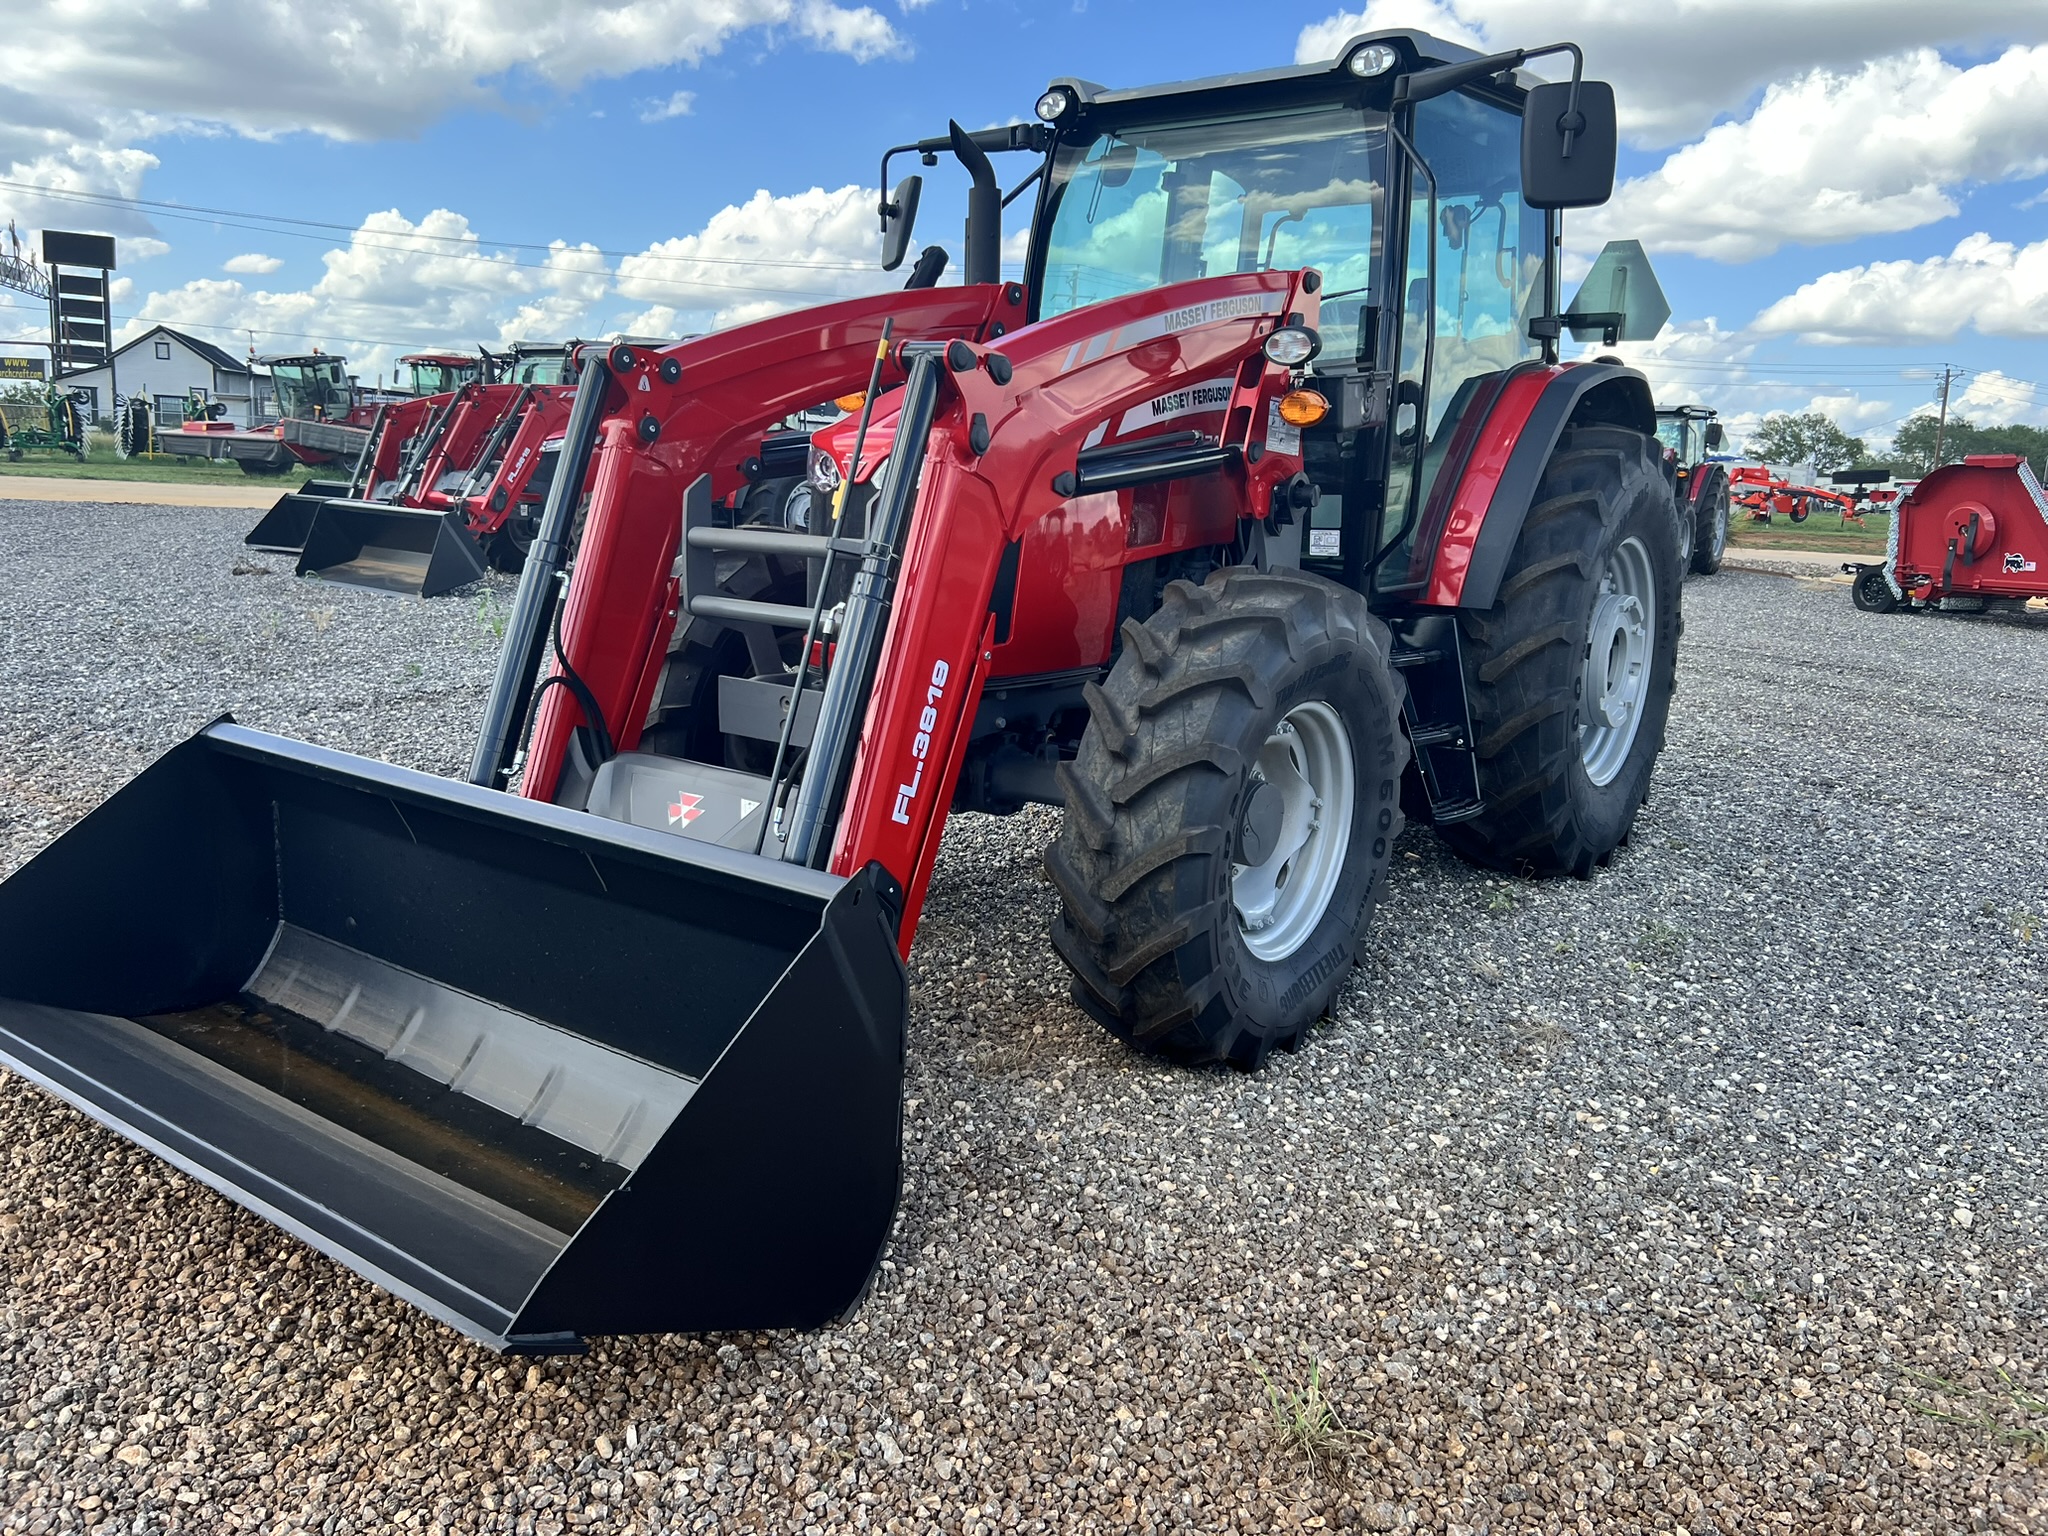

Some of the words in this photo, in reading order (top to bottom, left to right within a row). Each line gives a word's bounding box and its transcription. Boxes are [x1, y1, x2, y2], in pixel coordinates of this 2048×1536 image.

[1164, 305, 1207, 332] MASSEY
[1210, 296, 1262, 319] FERGUSON
[1151, 391, 1190, 417] MASSEY
[1192, 386, 1233, 406] FERGUSON
[891, 659, 949, 825] FL.3819
[1351, 867, 1377, 938] TUBELESS
[1279, 943, 1348, 1018] TRELLEBORG
